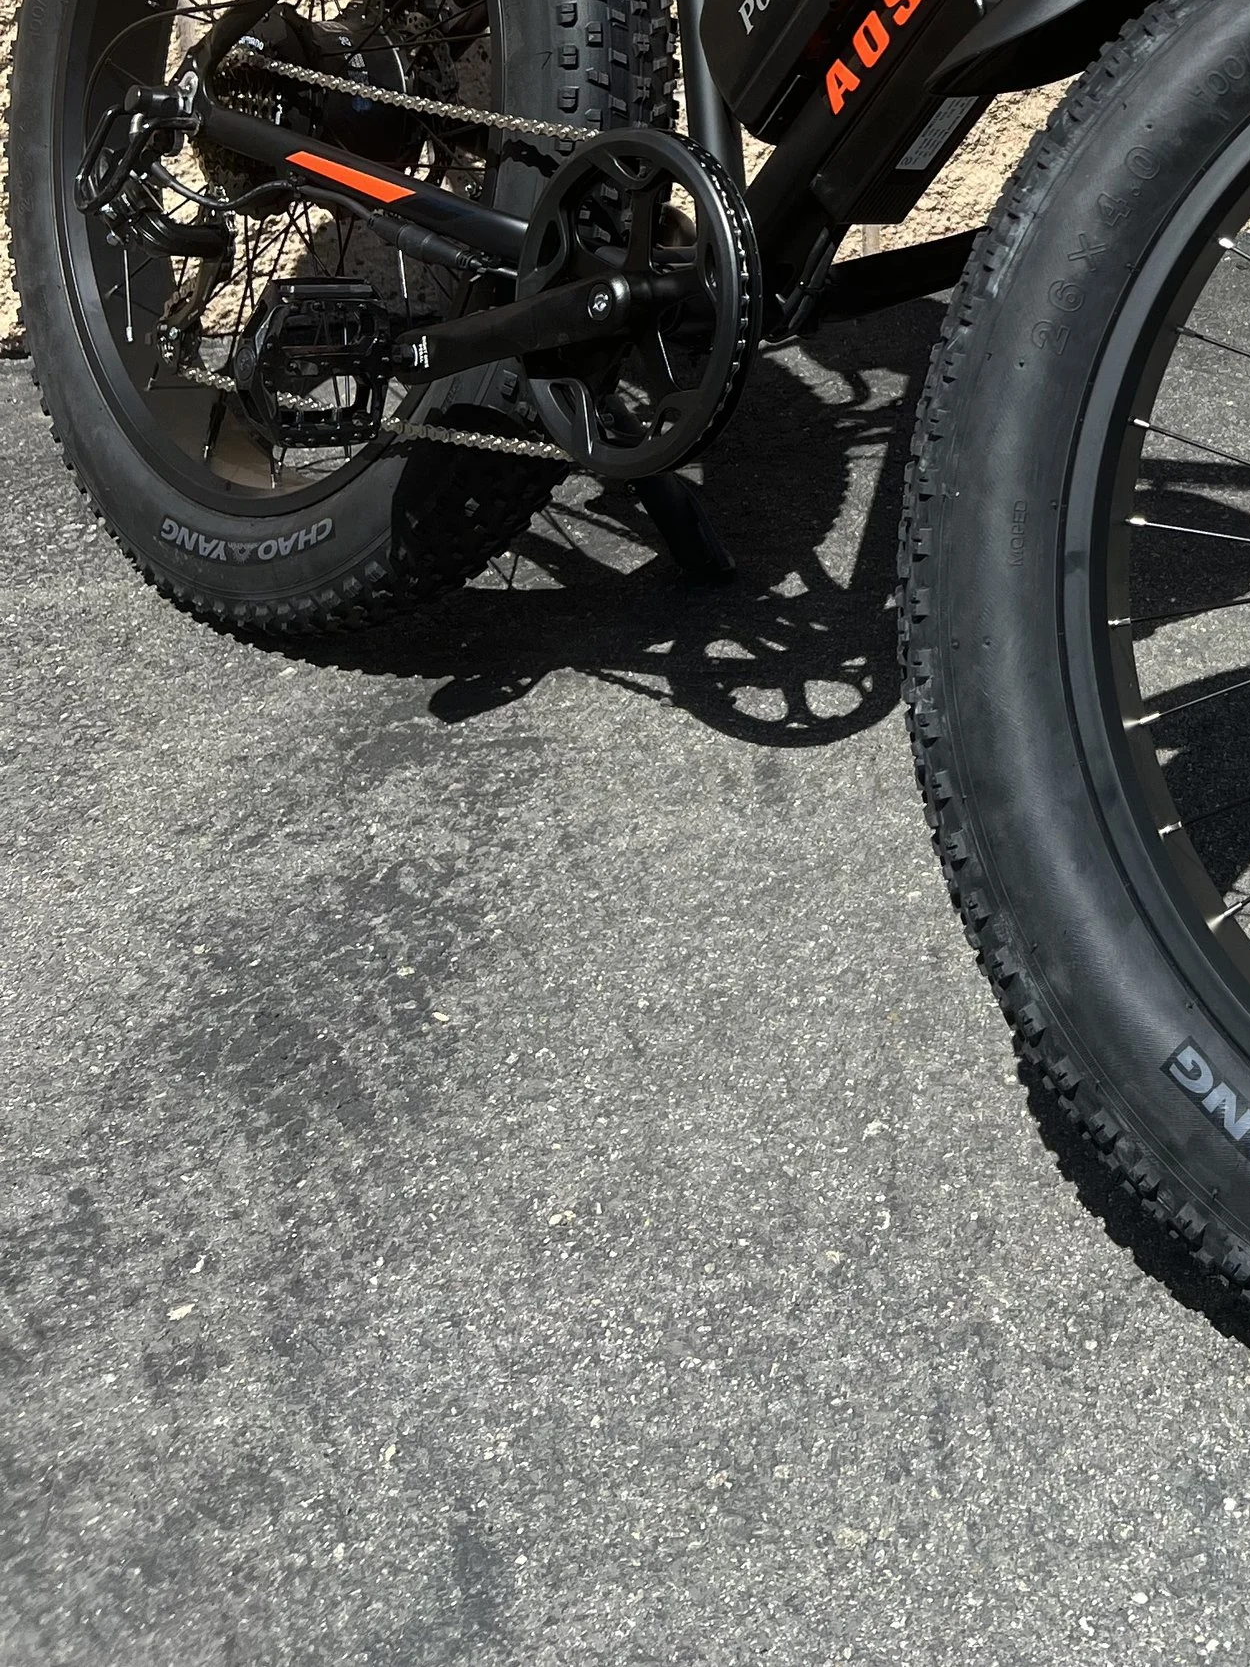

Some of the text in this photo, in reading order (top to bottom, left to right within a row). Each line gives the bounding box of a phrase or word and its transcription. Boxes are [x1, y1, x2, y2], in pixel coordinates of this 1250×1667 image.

[1031, 280, 1086, 356] 26
[1098, 146, 1161, 226] 4.0
[160, 517, 333, 562] CHAO YANG
[1009, 500, 1028, 567] MOPED
